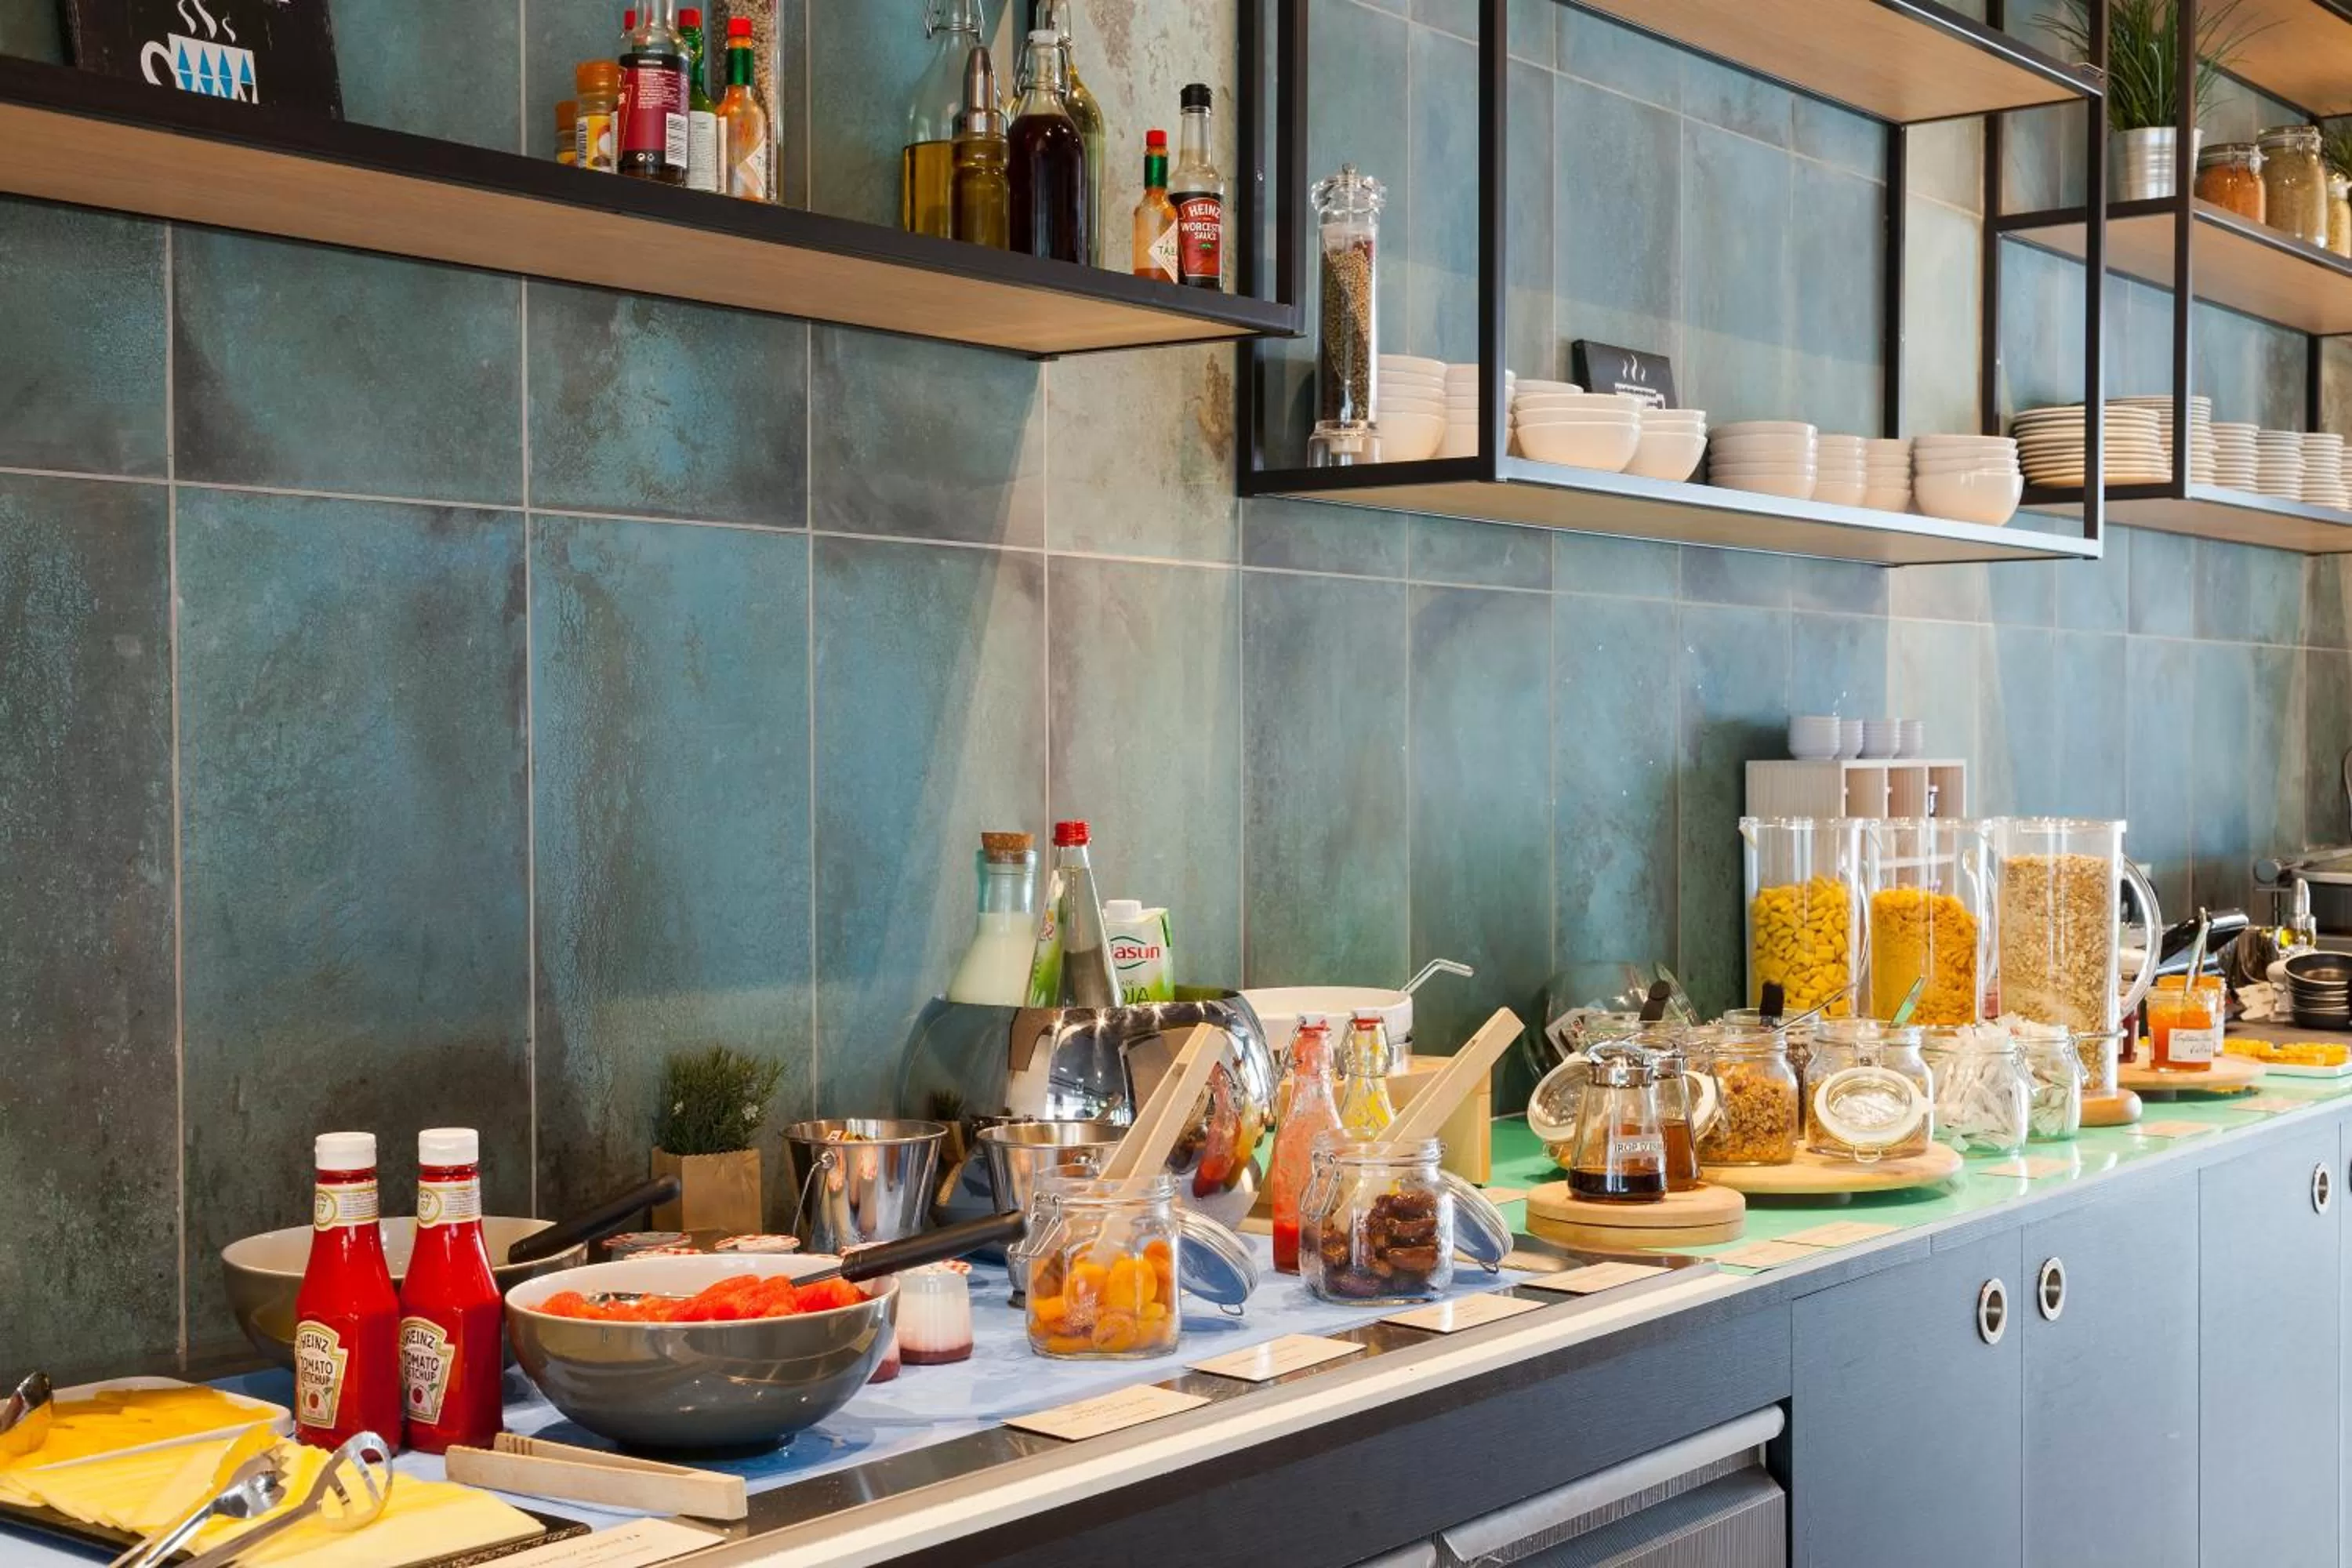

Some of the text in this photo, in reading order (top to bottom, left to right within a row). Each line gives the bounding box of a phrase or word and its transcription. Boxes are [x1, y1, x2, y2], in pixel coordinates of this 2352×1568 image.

[1188, 204, 1221, 218] HEINZ
[1112, 945, 1160, 959] asun
[300, 1334, 328, 1354] HEINZ
[405, 1329, 436, 1349] HEINZ
